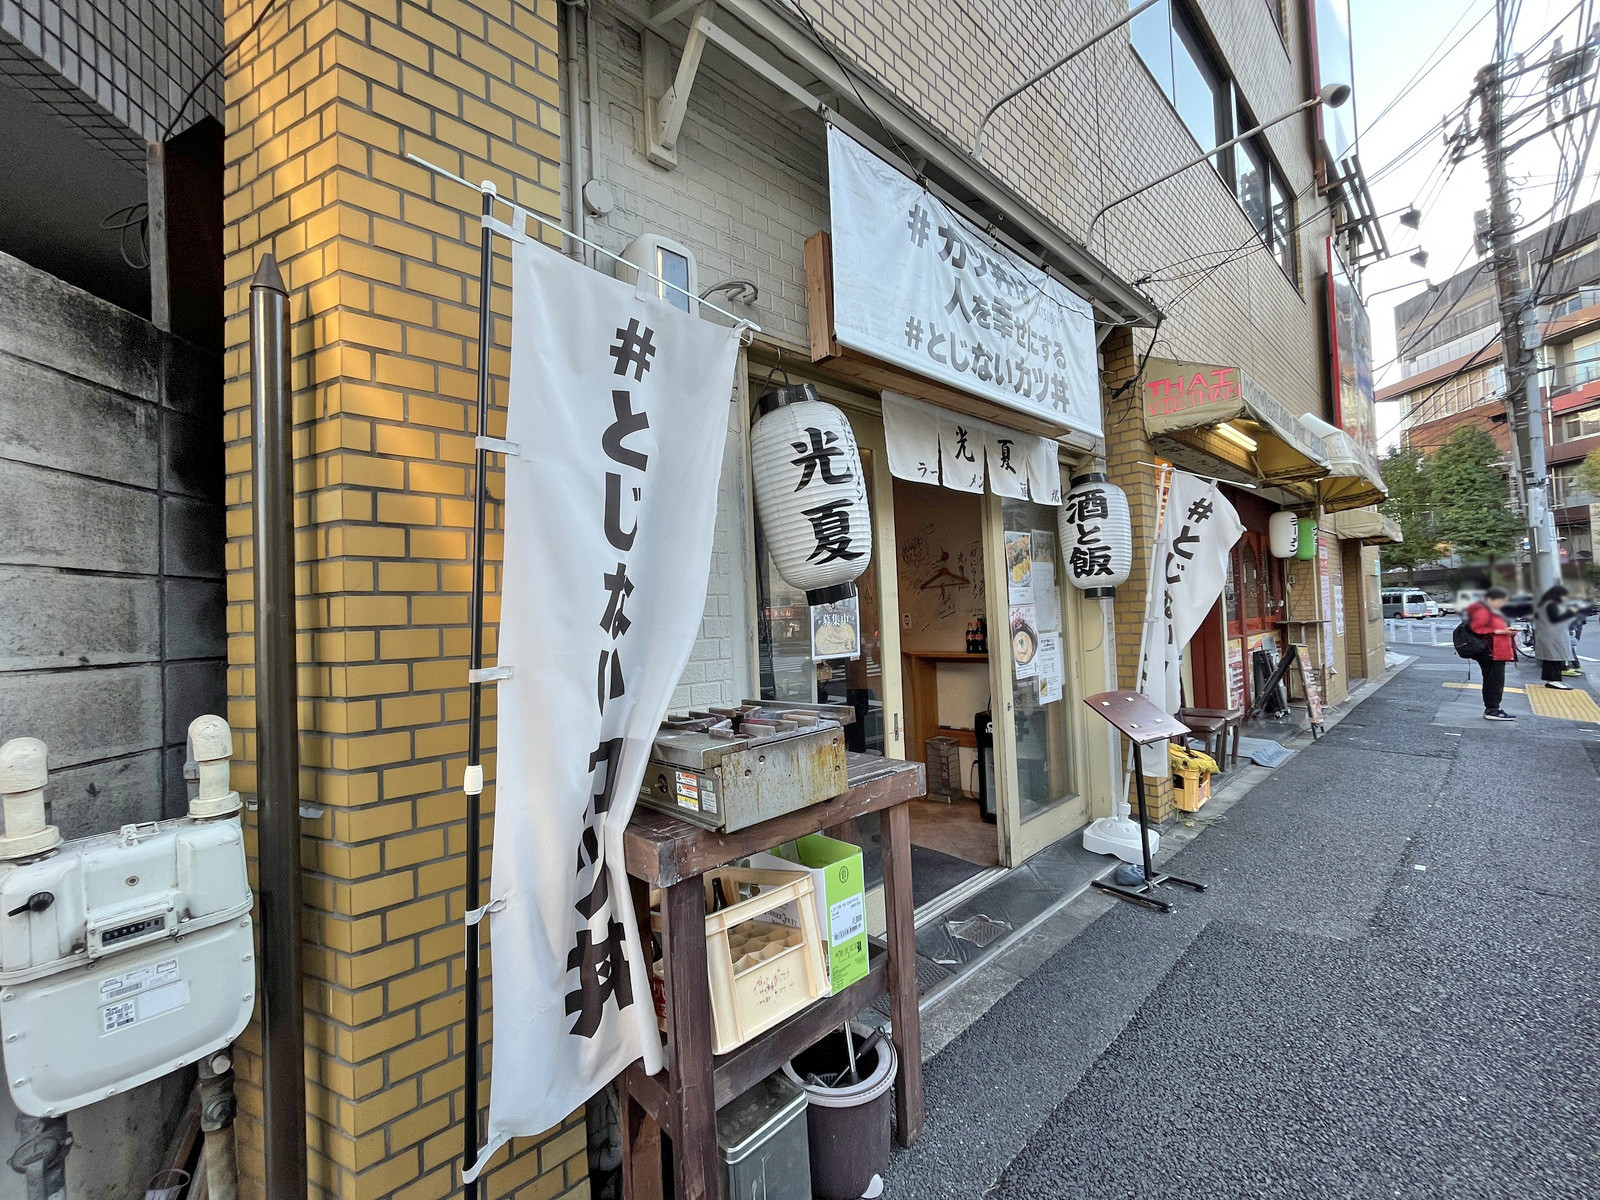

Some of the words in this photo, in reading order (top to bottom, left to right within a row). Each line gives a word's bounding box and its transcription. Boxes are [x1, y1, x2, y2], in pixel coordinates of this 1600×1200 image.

[904, 315, 1070, 413] #とじないカツ丼
[945, 277, 1067, 370] 人を幸せにする
[1147, 367, 1234, 398] THAI
[1147, 383, 1241, 416] VIETNAM
[954, 425, 1017, 475] 光夏
[790, 427, 866, 566] 光夏
[1065, 488, 1115, 579] 酒と飯
